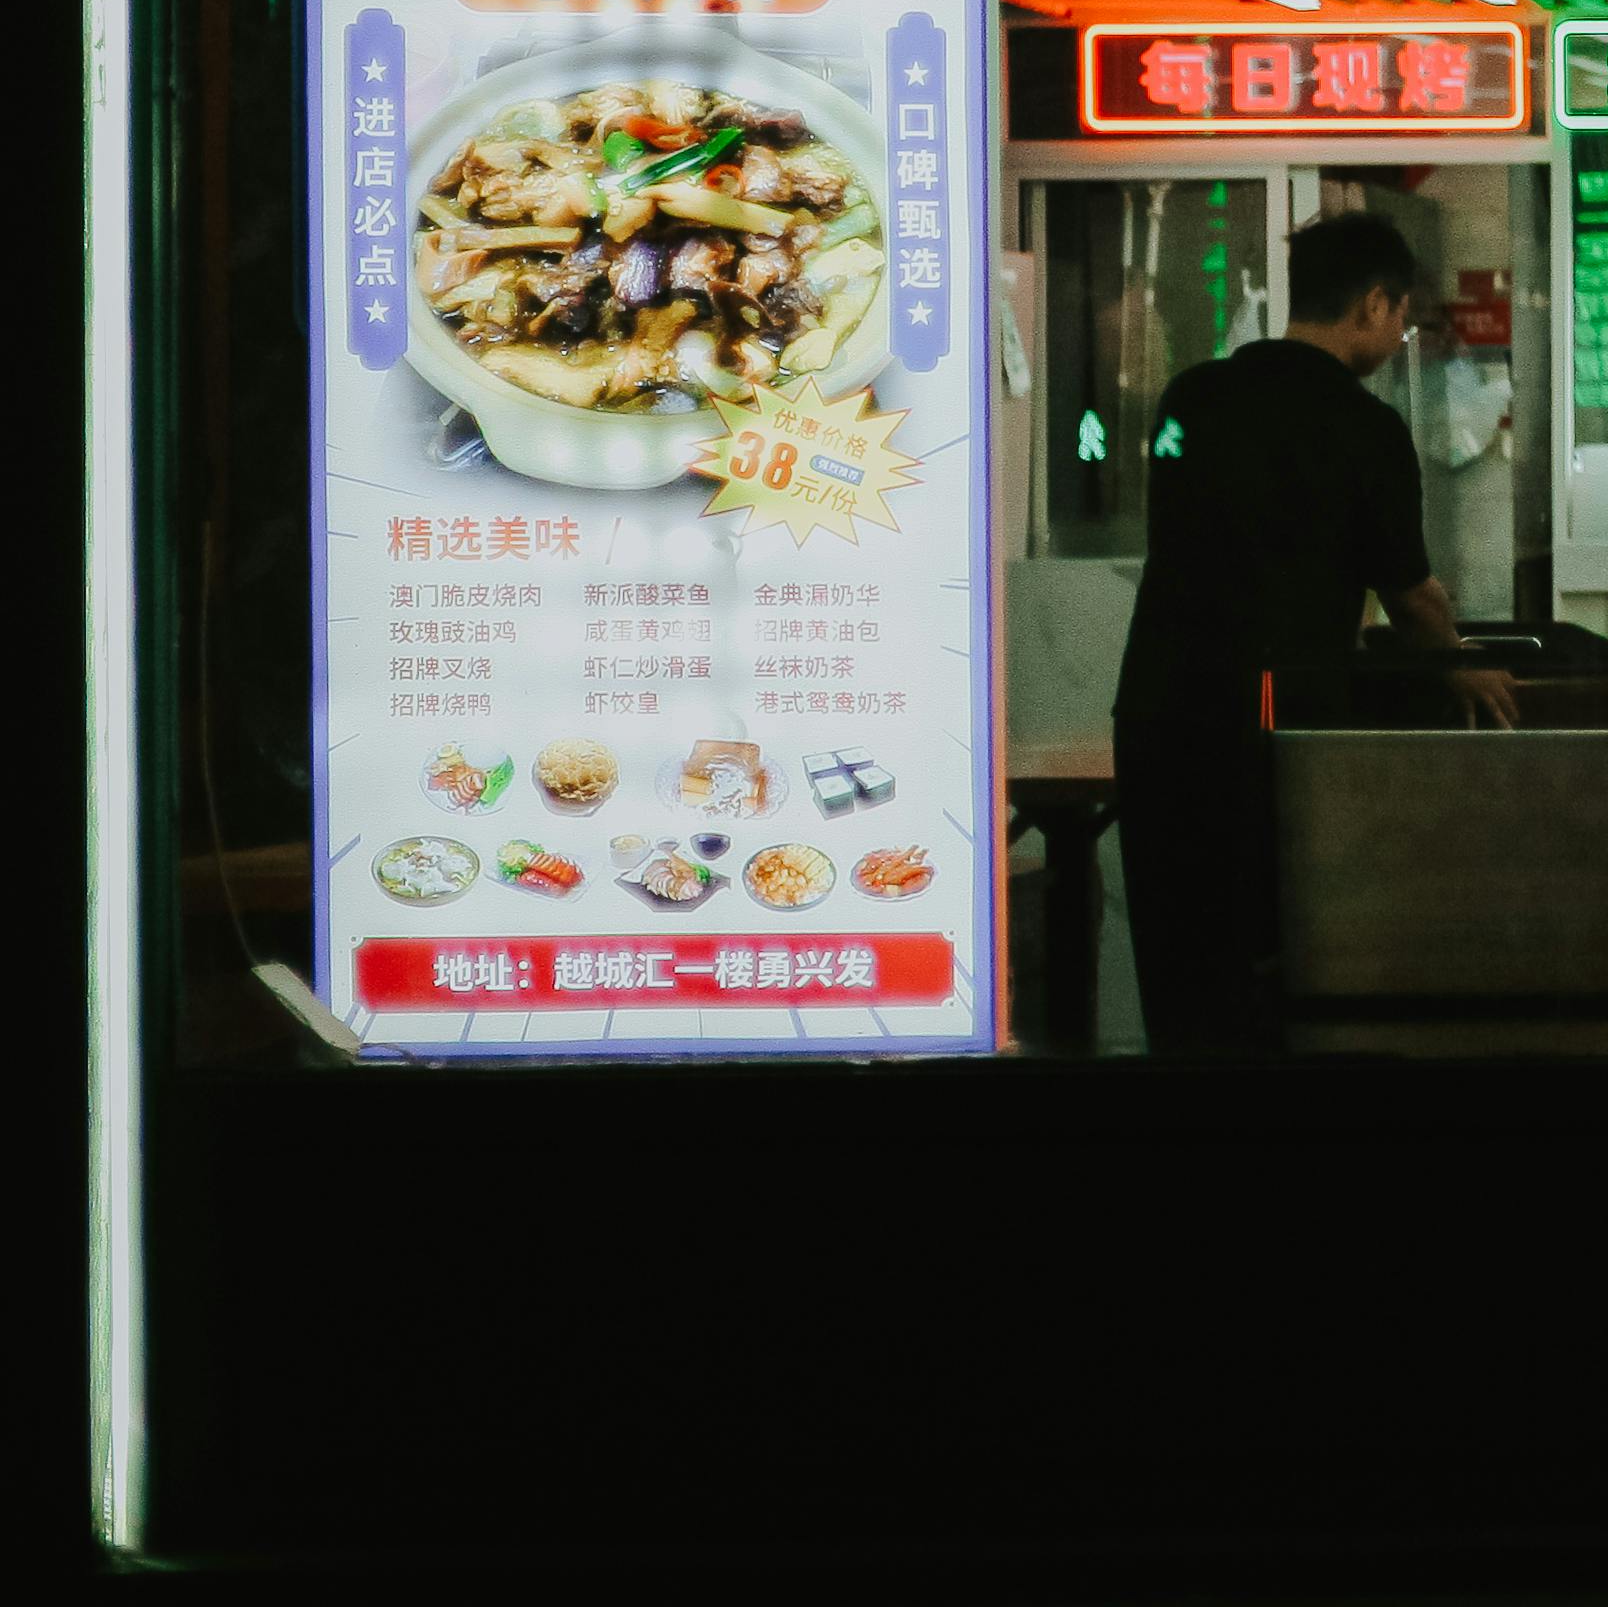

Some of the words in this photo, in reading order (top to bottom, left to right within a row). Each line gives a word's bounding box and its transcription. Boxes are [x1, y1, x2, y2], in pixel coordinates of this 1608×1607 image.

[1138, 38, 1470, 113] 每日现烤
[353, 97, 397, 287] 进店必点
[897, 102, 942, 290] 口碑甄选
[771, 406, 868, 460] 优惠价格
[386, 514, 581, 562] 精选美味
[389, 583, 541, 609] 澳门脆皮烧肉
[583, 583, 711, 608] 新派酸菜鱼
[753, 583, 880, 608] 金典漏奶华
[389, 619, 516, 645] 玫瑰豉油鸡
[584, 619, 711, 644] 咸蛋黄鸡翅
[753, 619, 880, 644] 招牌黄油包
[389, 656, 492, 681] 招牌叉烧
[583, 655, 712, 680] 虾仁炒滑蛋
[753, 655, 855, 680] 丝袜奶茶
[389, 692, 492, 718] 招牌烧鸭
[584, 691, 661, 716] 虾饺皇
[754, 690, 907, 716] 港式鸳鸯奶茶
[432, 950, 874, 992] 地址：越城汇一楼勇兴发
